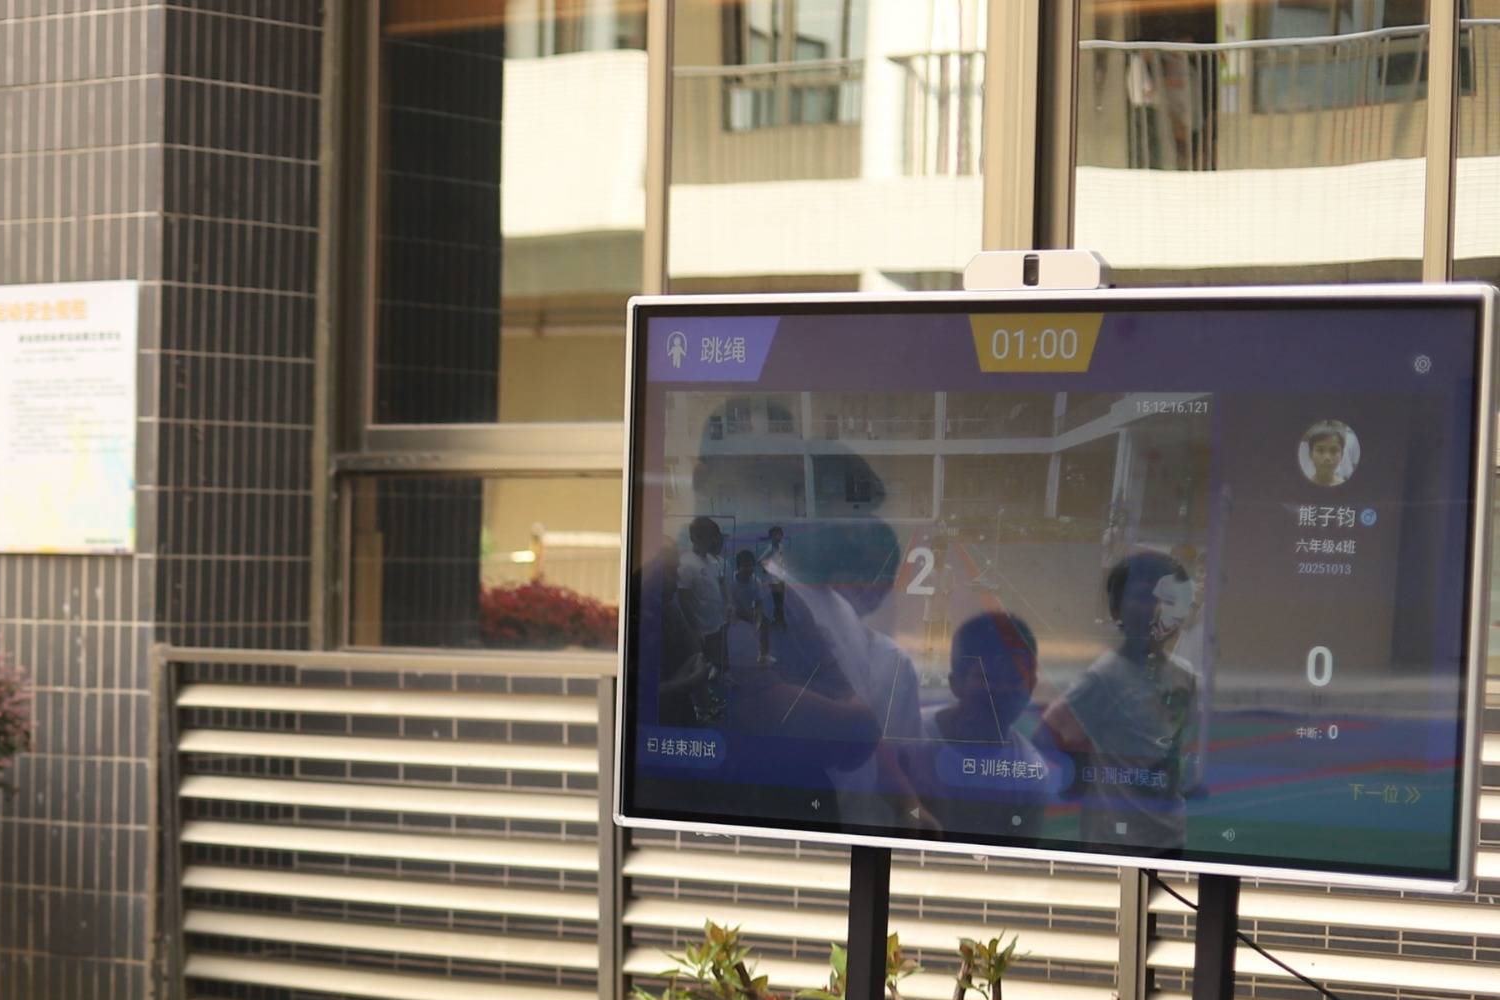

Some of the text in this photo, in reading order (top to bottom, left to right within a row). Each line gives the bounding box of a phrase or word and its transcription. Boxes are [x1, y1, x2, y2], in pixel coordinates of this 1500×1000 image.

[700, 336, 746, 364] 跳绳
[991, 329, 1078, 359] 01:00
[1135, 401, 1209, 414] 15:12:16.121
[1295, 539, 1356, 554] 六年级4班
[906, 547, 935, 595] 2
[1298, 563, 1352, 575] 20251013
[1307, 645, 1333, 687] 0
[1328, 725, 1338, 740] 0
[661, 738, 716, 758] 结束测试
[980, 759, 1045, 780] 训练模式
[1101, 767, 1166, 788] 测试模式
[1349, 783, 1399, 803] 下一位
